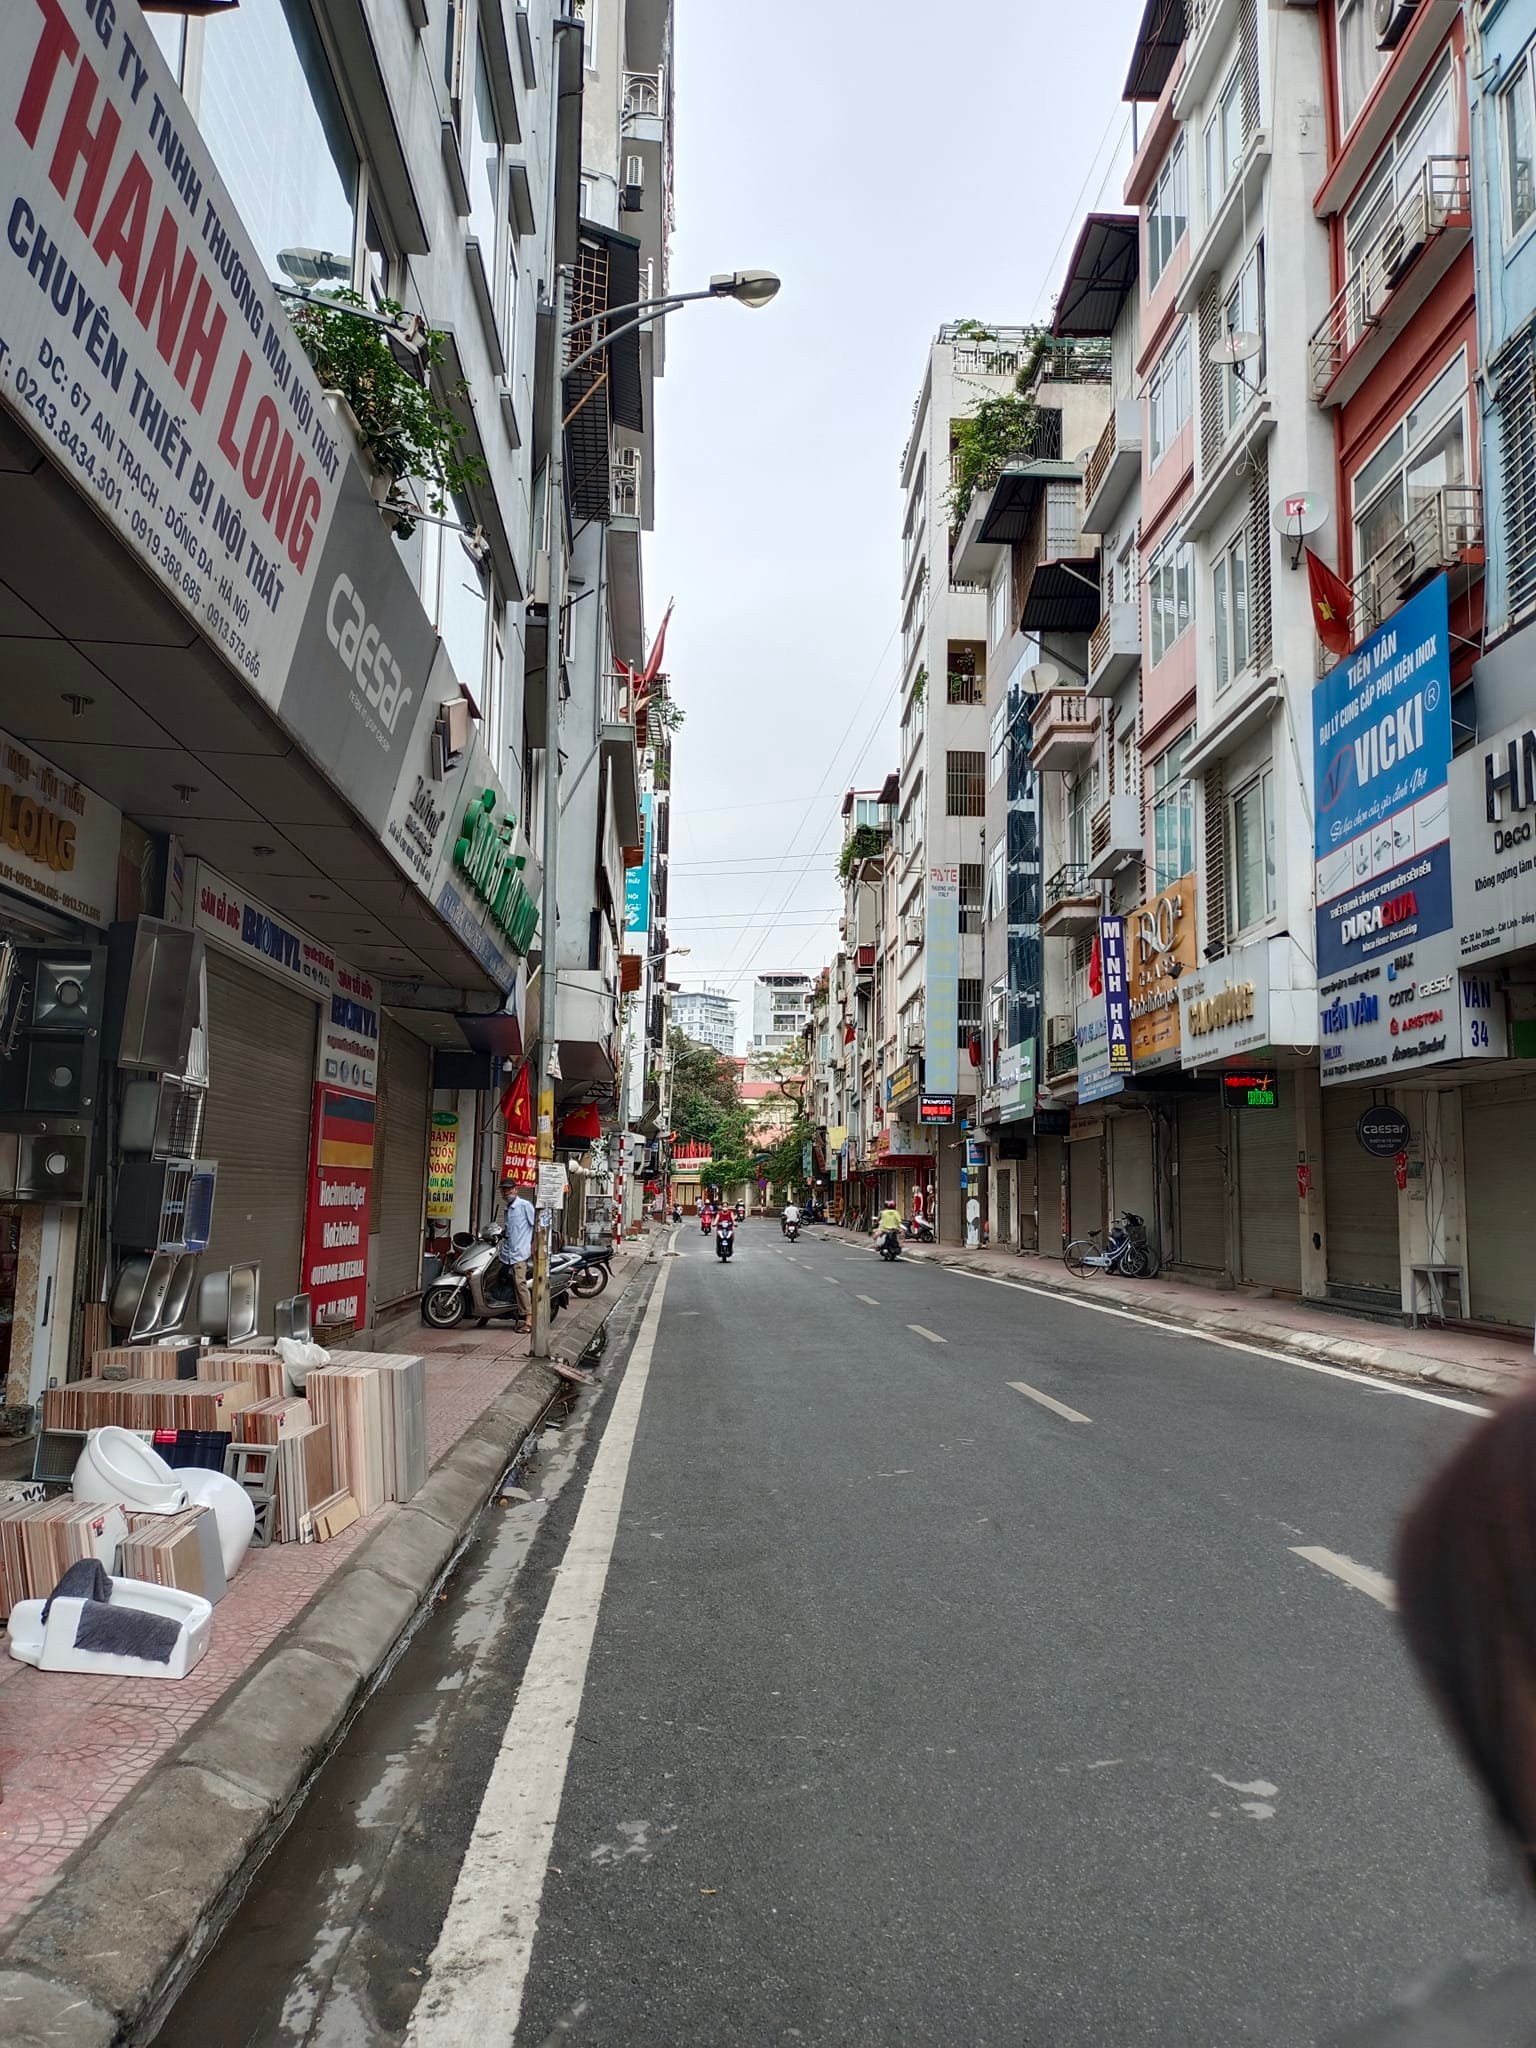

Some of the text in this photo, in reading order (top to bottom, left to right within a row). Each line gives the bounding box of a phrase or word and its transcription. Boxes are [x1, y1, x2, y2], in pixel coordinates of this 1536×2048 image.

[14, 0, 322, 576] THANH LONG
[118, 31, 149, 105] TY
[149, 92, 203, 217] TNHH
[201, 199, 265, 340] THƯƠNG
[262, 321, 292, 393] MẠI
[288, 388, 315, 432] NỘI
[312, 418, 340, 484] THẤT
[7, 196, 285, 614] CHUYÊN THIẾT BỊ NỘI THẤT
[15, 366, 123, 511] 0243.8434.301
[130, 508, 203, 608] 0919.368.685
[69, 382, 93, 417] 67
[90, 410, 117, 452] AN
[113, 439, 161, 509] TRẠCH
[164, 504, 200, 559] ĐỐNG
[217, 576, 233, 607] HÀ
[232, 594, 251, 629] NỘI
[1347, 629, 1397, 690] TIẾN VÂN
[1376, 669, 1393, 700] PHỤ
[1394, 653, 1414, 684] KIỆN
[1415, 633, 1437, 669] INOX
[1354, 691, 1424, 788] VICKI
[1494, 822, 1531, 854] Deco
[1341, 889, 1418, 945] DURAQUA
[1103, 921, 1121, 993] MINH
[1110, 1003, 1125, 1040] HÀ
[1401, 1009, 1443, 1032] ARISTON
[1463, 976, 1491, 1009] VÂN
[1111, 1043, 1127, 1056] 38
[1471, 1020, 1489, 1048] 34
